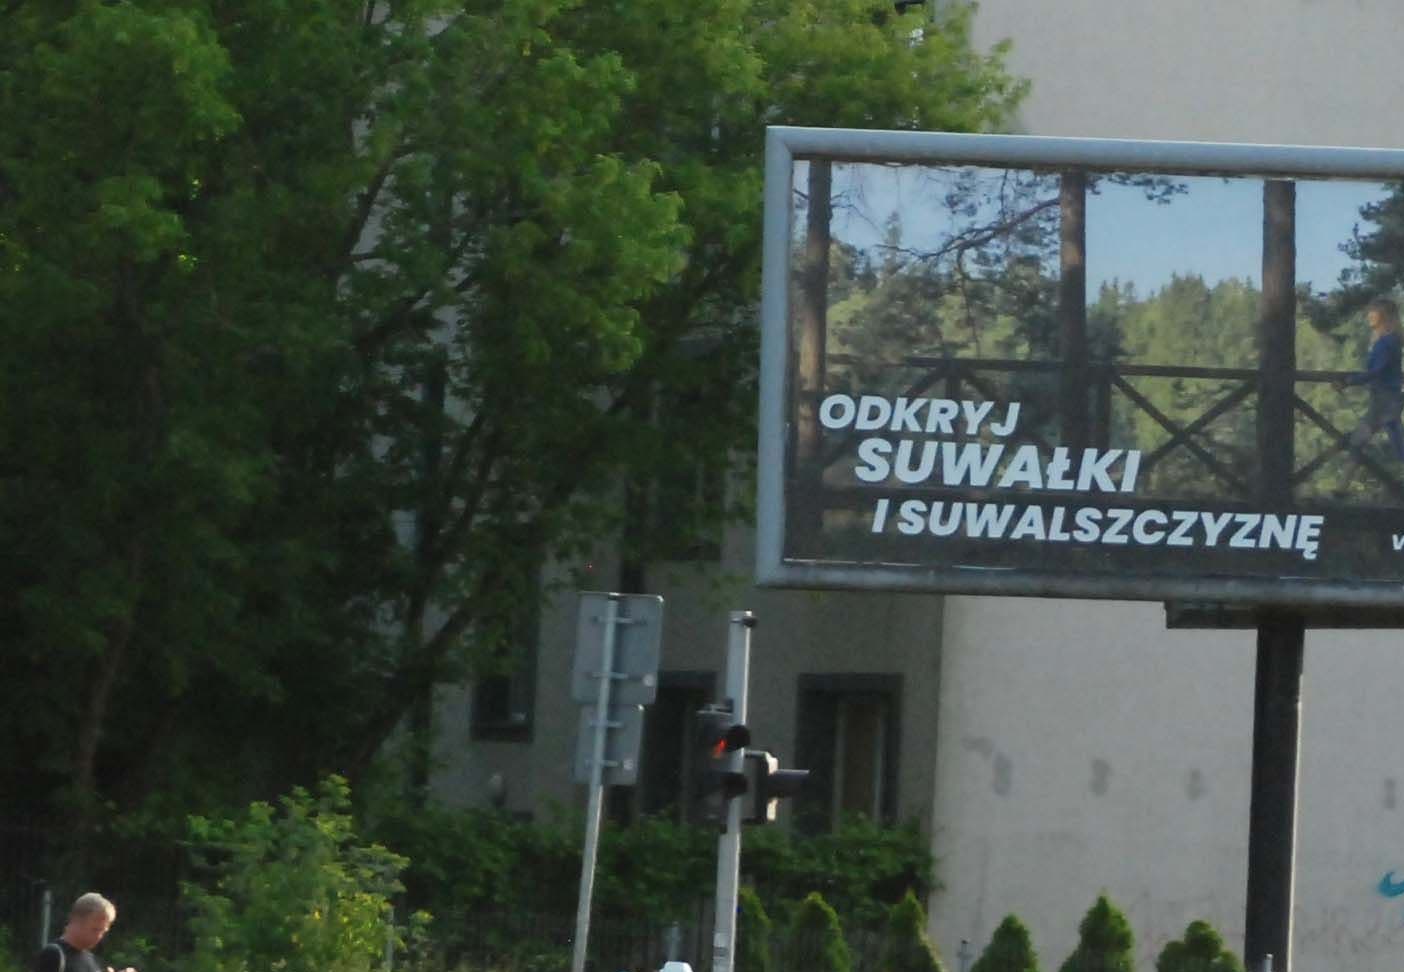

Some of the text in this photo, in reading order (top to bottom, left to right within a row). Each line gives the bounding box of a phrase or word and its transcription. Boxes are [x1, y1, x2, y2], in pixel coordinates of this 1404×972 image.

[819, 394, 1021, 436] ODKRYJ
[855, 438, 1141, 492] SUWAŁKI
[872, 499, 1324, 560] I SUWALSZCZYZNĘ
